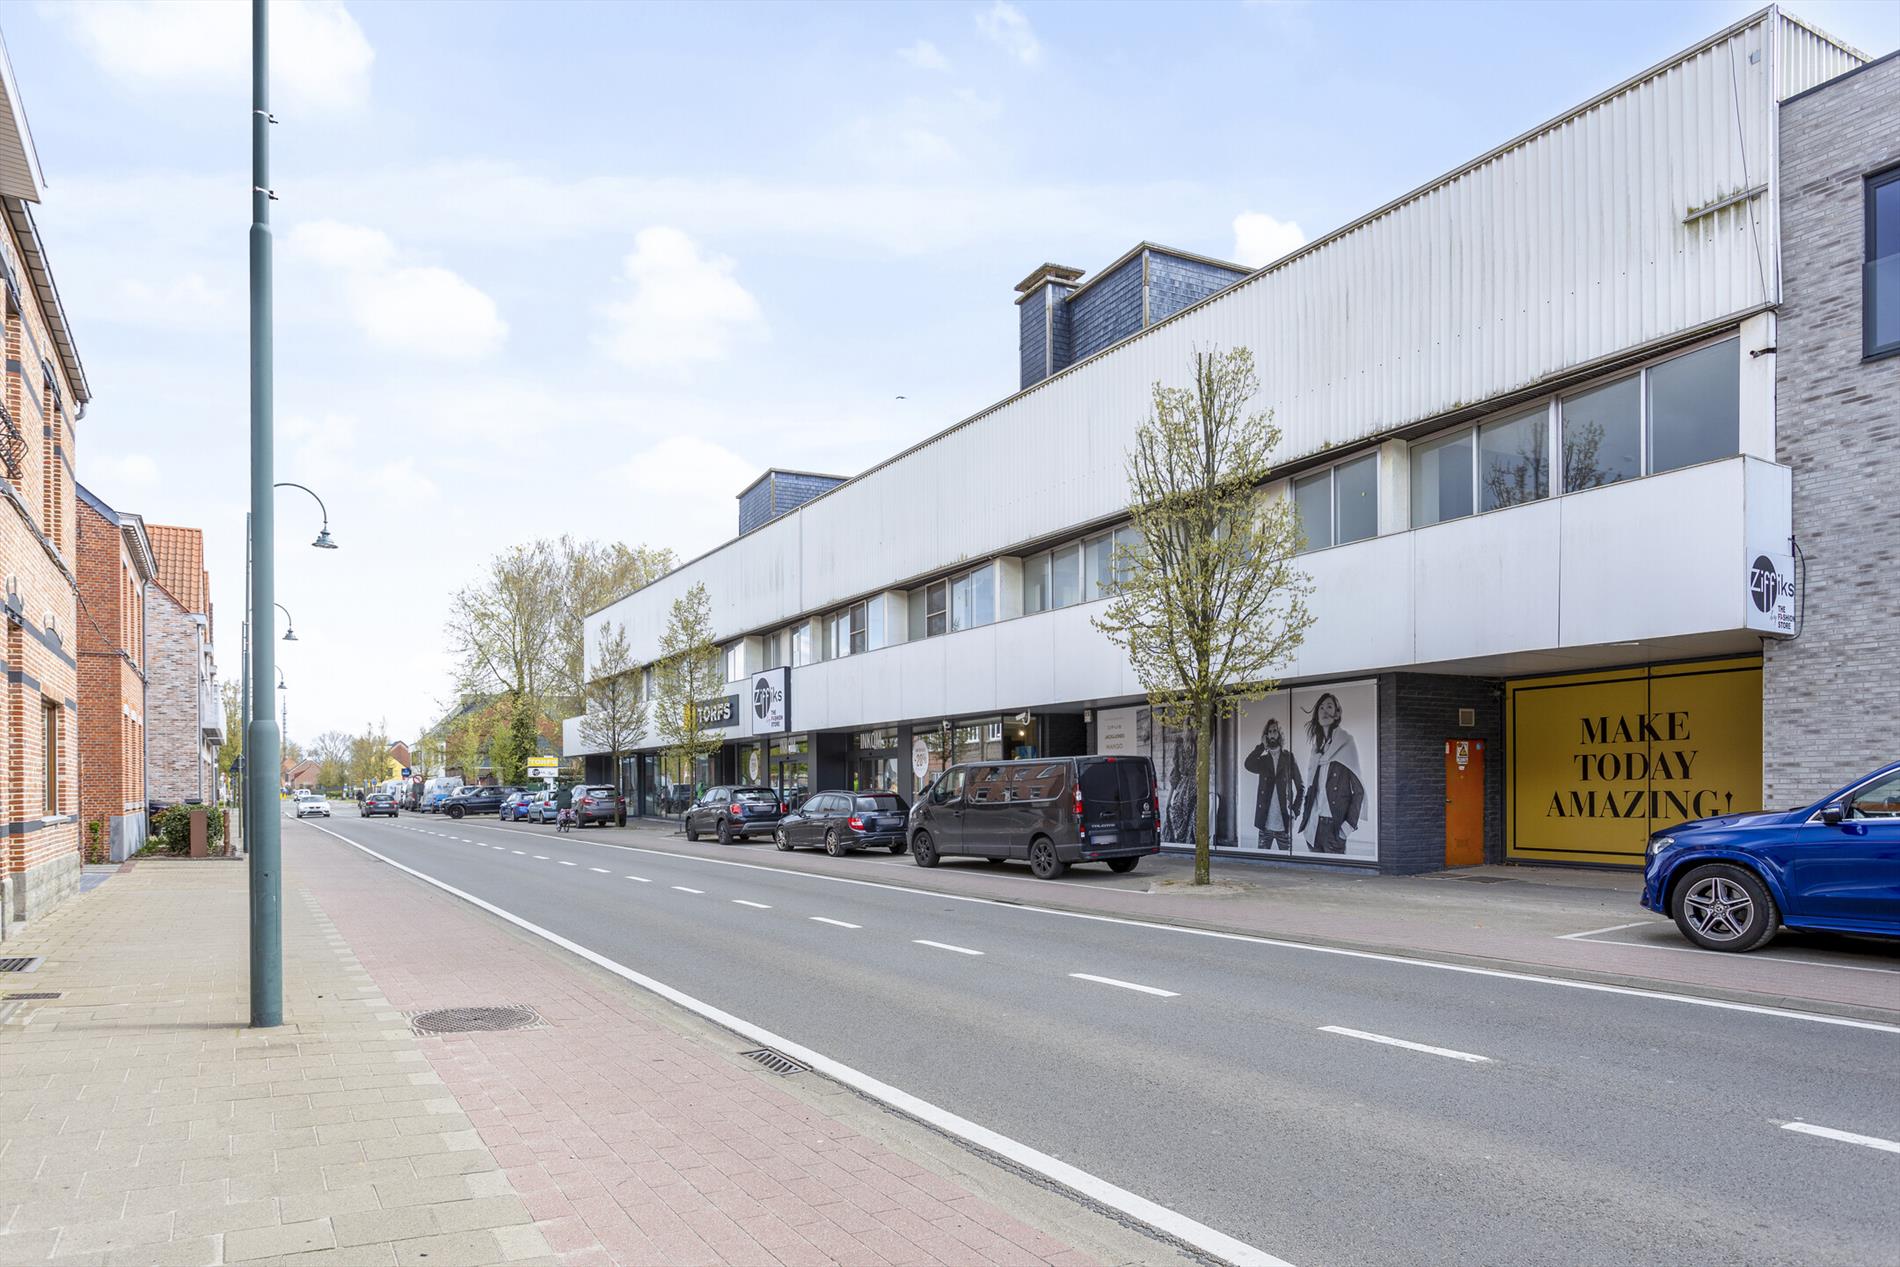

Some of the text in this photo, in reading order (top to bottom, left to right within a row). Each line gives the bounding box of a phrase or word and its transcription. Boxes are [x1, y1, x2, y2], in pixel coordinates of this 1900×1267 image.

[1777, 605, 1786, 613] THE
[1777, 621, 1791, 630] STORE
[697, 703, 731, 723] TORFS
[1579, 711, 1690, 745] MAKE
[1573, 750, 1698, 782] TODAY
[1546, 789, 1735, 819] AMAZING!
